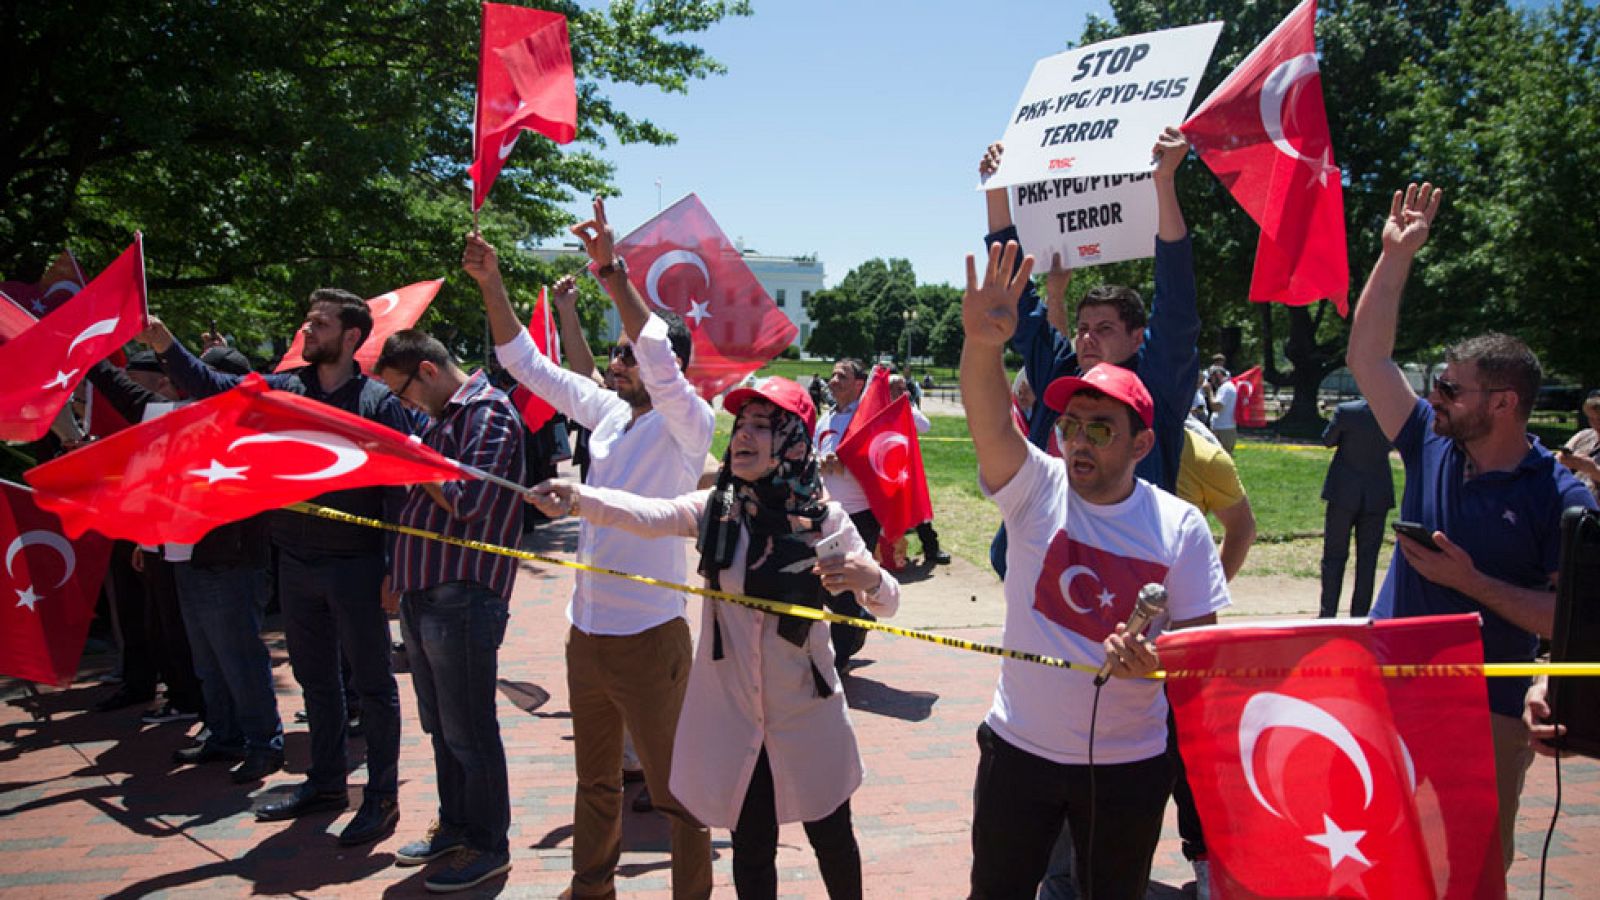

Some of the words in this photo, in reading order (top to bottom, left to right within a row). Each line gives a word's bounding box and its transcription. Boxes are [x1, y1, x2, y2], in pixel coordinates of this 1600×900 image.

[1071, 43, 1150, 82] STOP
[1015, 77, 1189, 124] PKK-YPG/PYD-ISIS
[1040, 118, 1119, 148] TERROR
[1056, 202, 1122, 234] TERROR
